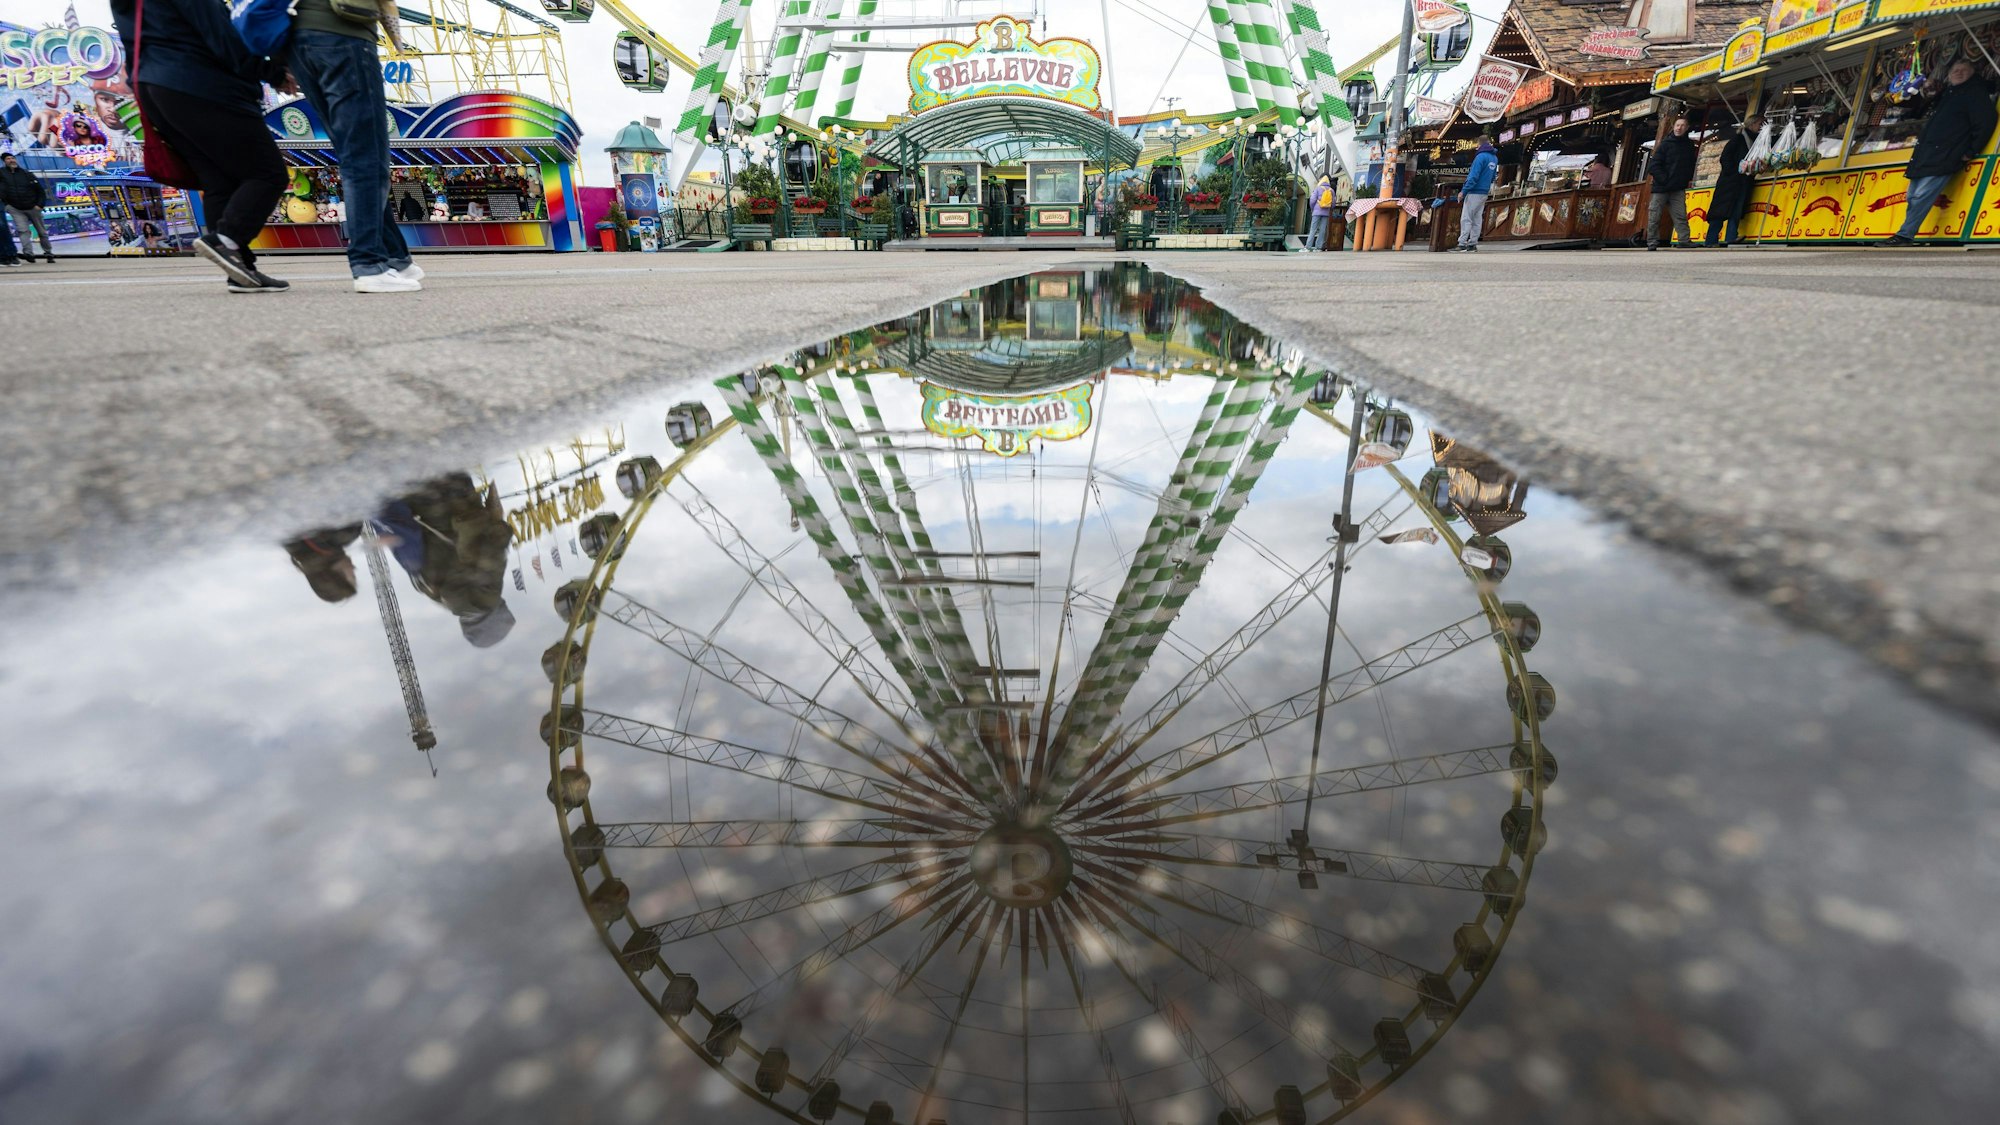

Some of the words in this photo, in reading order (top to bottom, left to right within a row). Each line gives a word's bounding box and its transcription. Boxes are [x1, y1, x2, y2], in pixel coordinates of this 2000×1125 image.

[994, 25, 1014, 50] B
[933, 57, 1074, 90] BELLEVUE
[1474, 86, 1507, 103] Knacker
[66, 143, 106, 156] DISCO
[56, 181, 88, 198] DIS
